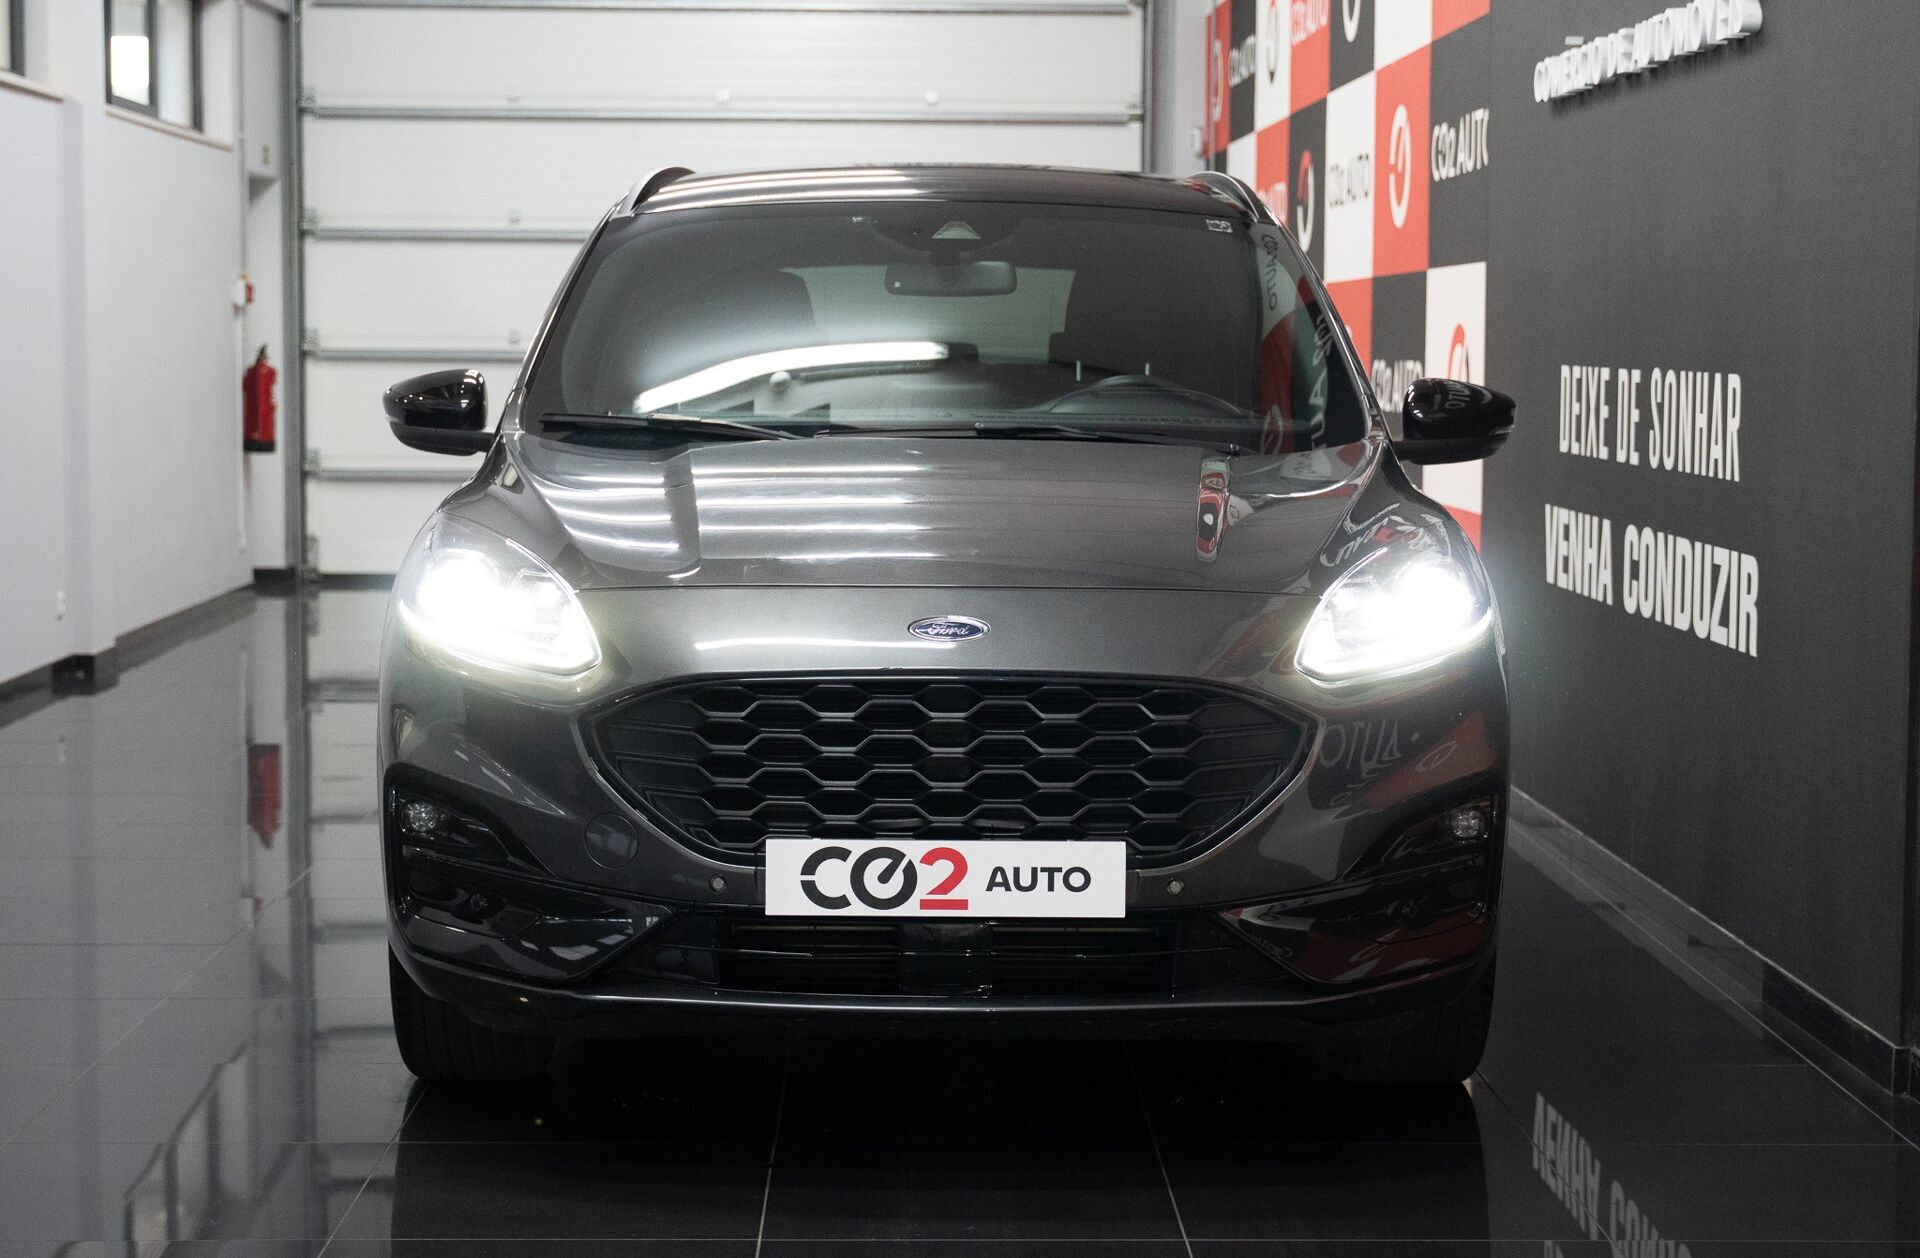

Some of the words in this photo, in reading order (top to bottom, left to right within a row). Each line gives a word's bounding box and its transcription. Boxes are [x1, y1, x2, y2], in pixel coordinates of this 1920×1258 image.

[1431, 121, 1457, 182] CO2
[1559, 364, 1611, 460] DEIXE
[1616, 368, 1642, 466] DE
[1649, 367, 1742, 482] SONHAR
[1545, 503, 1613, 606] VENHA
[1623, 523, 1759, 658] CONDUZIR
[915, 621, 970, 636] Ford
[800, 846, 969, 911] CO2
[985, 865, 1092, 893] AUTO
